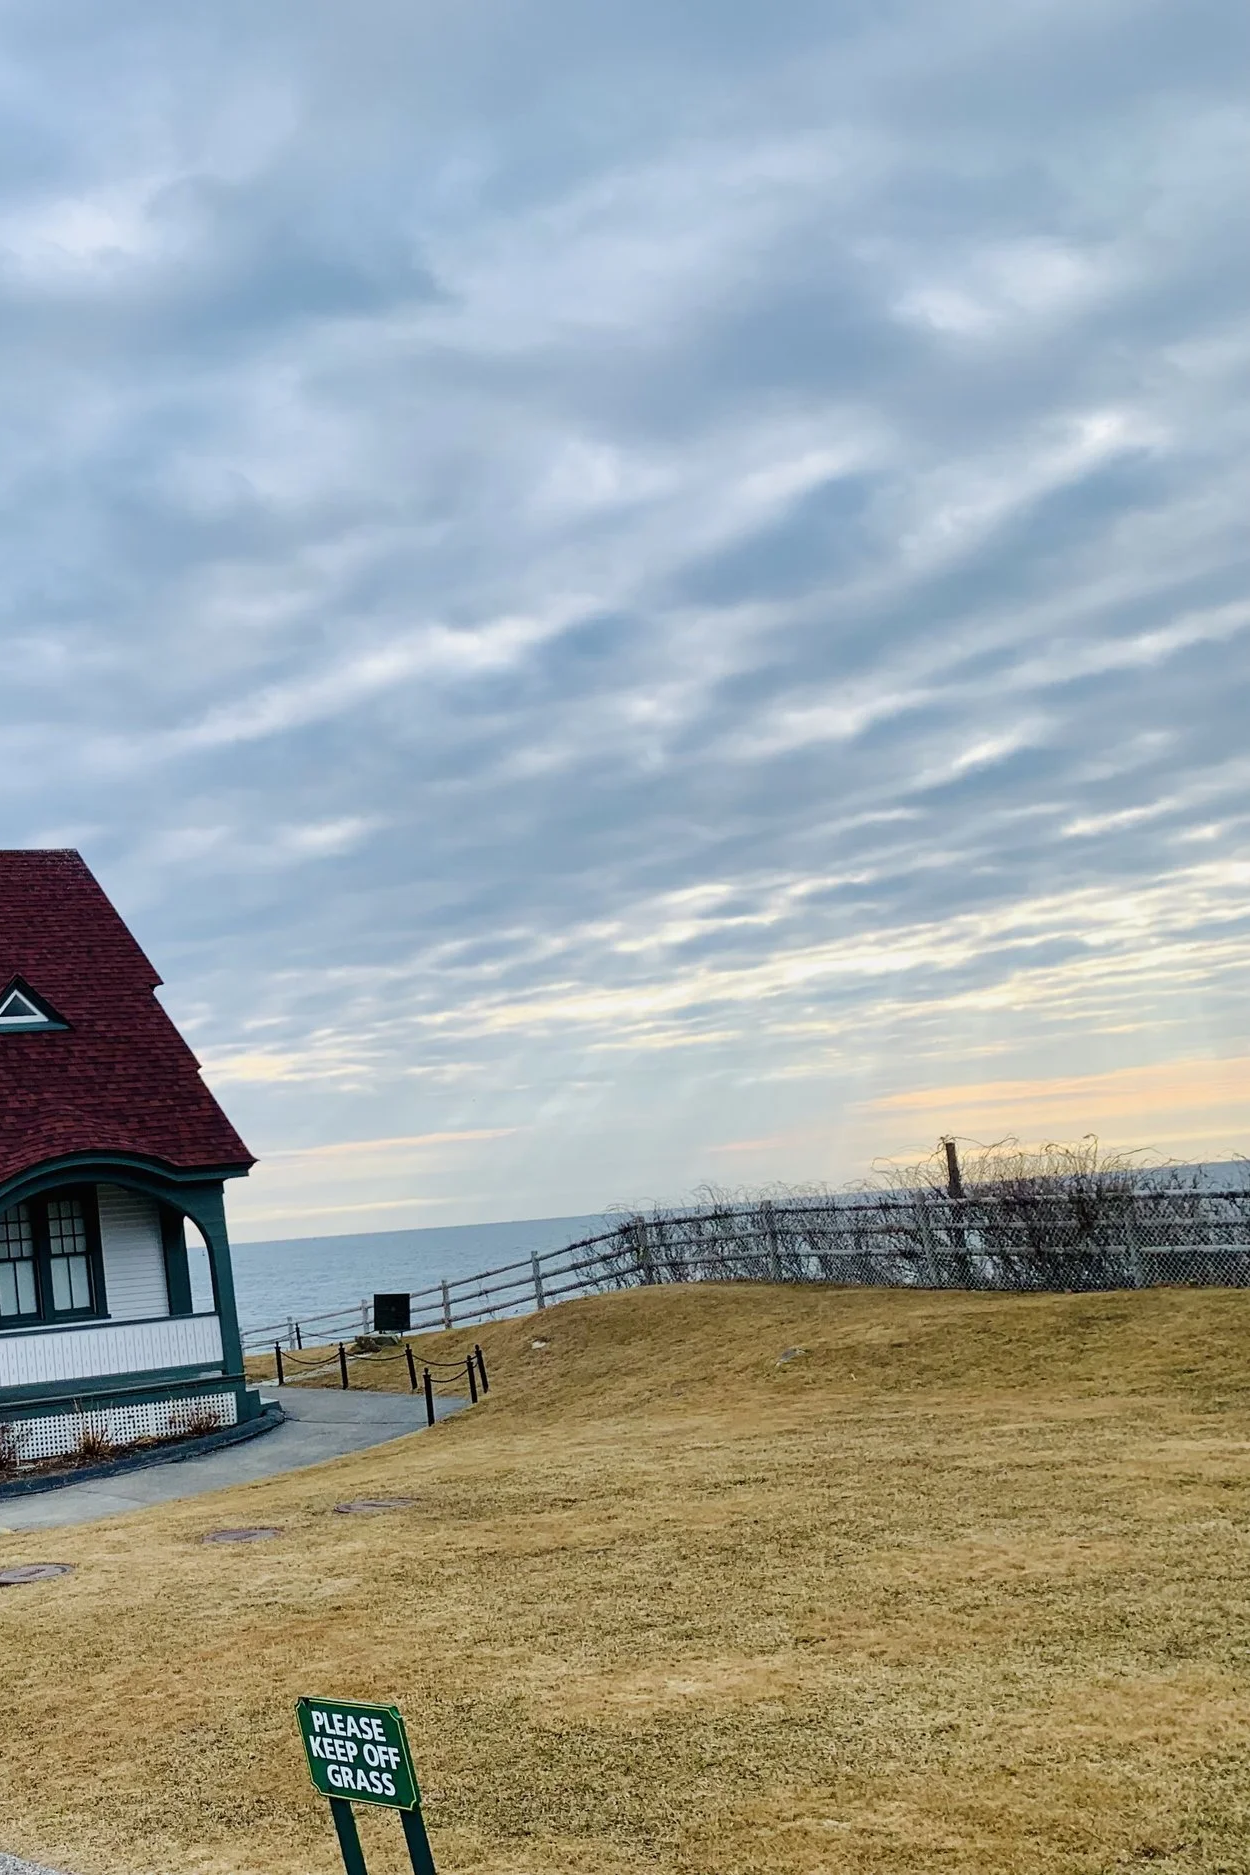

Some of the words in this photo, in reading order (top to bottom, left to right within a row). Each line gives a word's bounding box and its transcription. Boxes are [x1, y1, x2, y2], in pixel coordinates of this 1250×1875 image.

[311, 1710, 386, 1742] PLEASE
[309, 1735, 358, 1763] KEEP
[362, 1743, 401, 1770] OFF
[326, 1764, 396, 1796] GRASS
